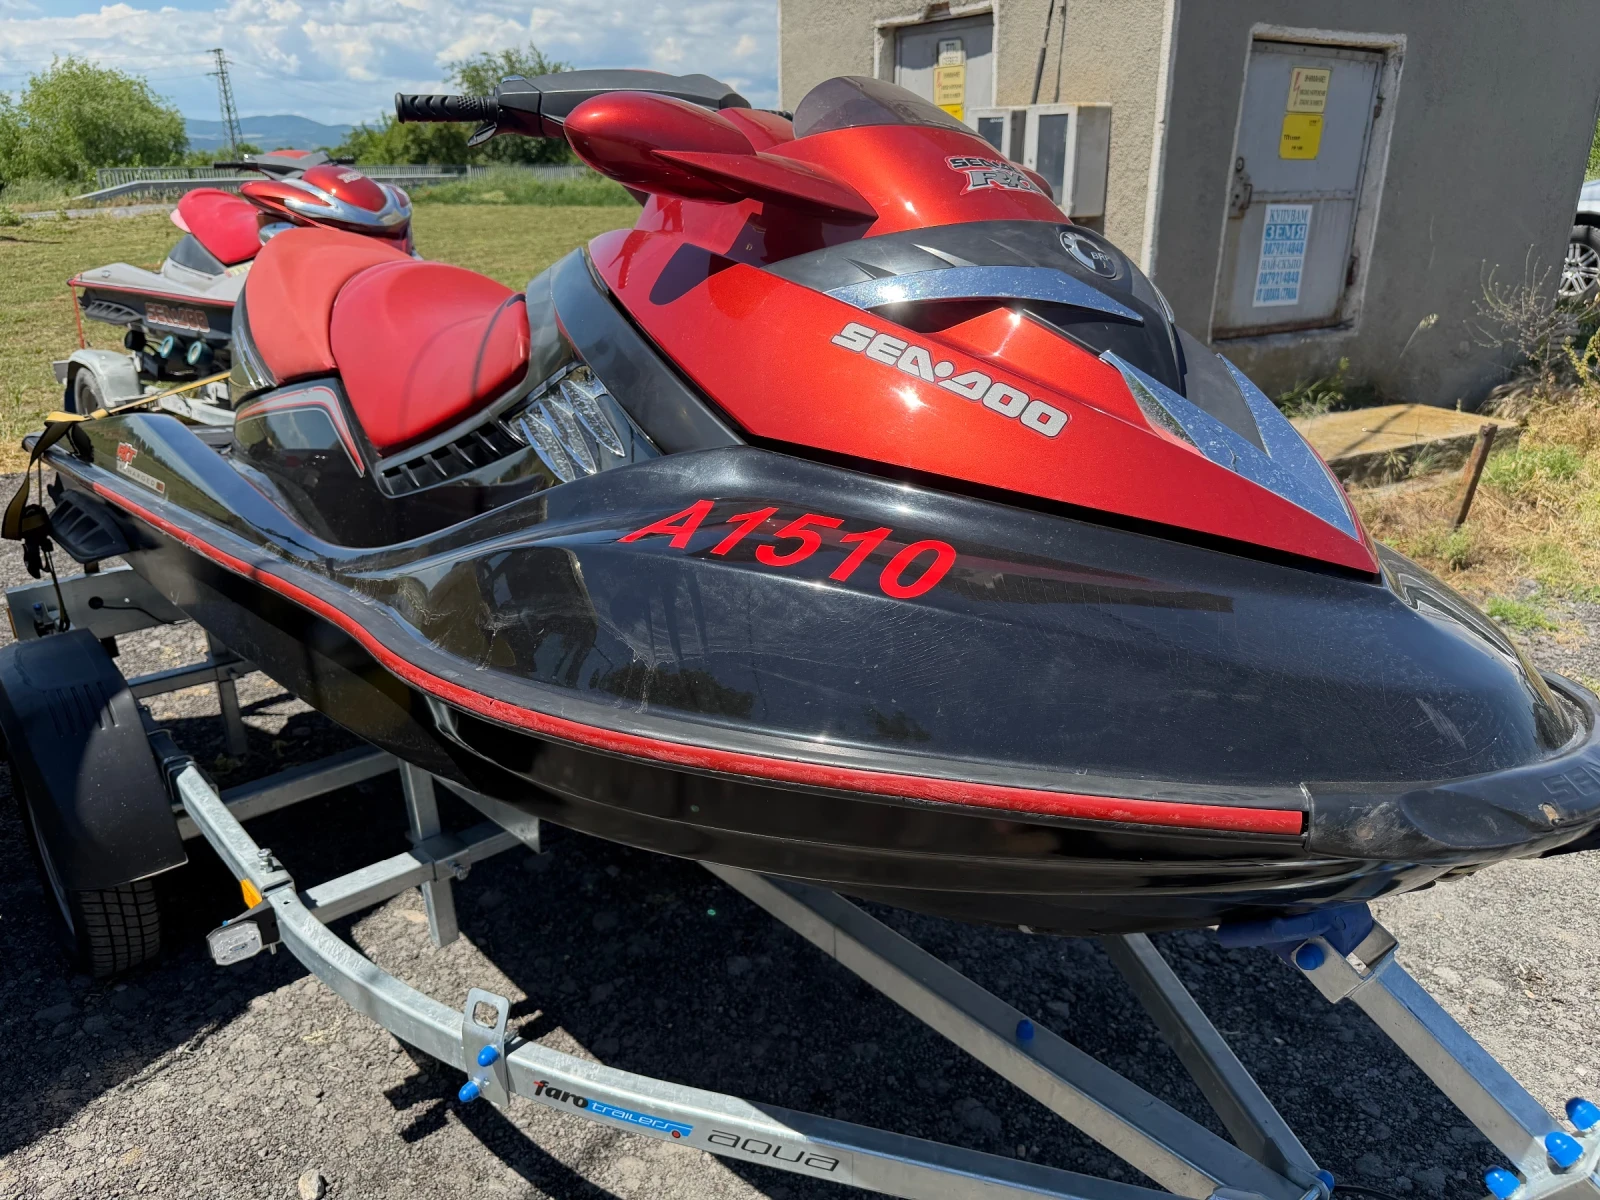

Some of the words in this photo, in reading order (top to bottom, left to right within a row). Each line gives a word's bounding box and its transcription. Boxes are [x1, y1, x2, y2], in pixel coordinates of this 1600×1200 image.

[1265, 224, 1306, 240] ЗЕМЯ
[617, 499, 957, 599] A1510
[533, 1079, 589, 1109] faro
[591, 1102, 682, 1130] trailers
[707, 1128, 840, 1173] aqua
